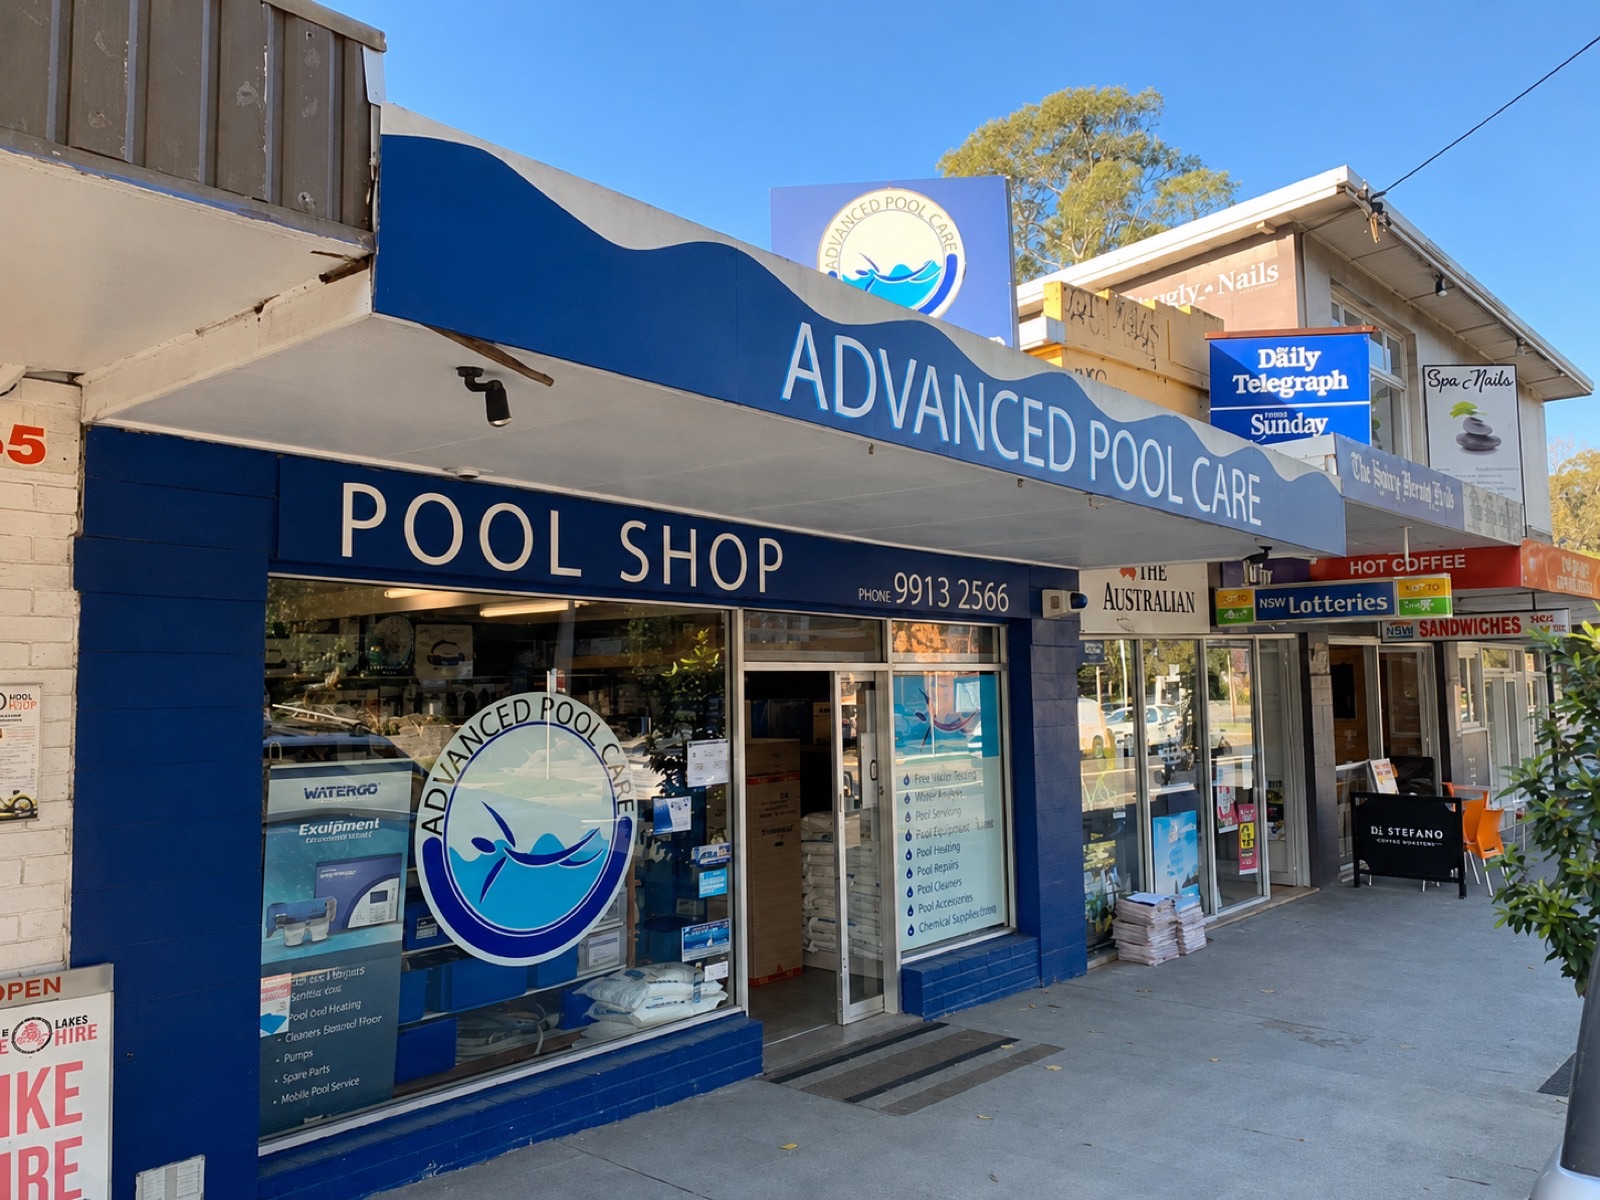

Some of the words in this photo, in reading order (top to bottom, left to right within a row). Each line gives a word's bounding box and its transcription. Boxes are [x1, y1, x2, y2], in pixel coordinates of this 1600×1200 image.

[825, 199, 881, 270] ADVANCED
[885, 196, 927, 218] POOL
[928, 212, 958, 253] CARE
[1217, 261, 1279, 295] Nails
[1232, 369, 1349, 398] Telegraph
[1427, 368, 1459, 393] Spa
[780, 321, 1076, 473] ADVANCED
[1088, 419, 1184, 505] POOL
[1190, 456, 1263, 527] CARE
[1251, 412, 1329, 437] Sunday
[0, 424, 46, 465] 5
[340, 481, 582, 578] POOL
[619, 520, 784, 593] SHOP
[1140, 565, 1168, 581] THE
[1350, 559, 1388, 575] HOT
[1392, 554, 1466, 572] COFFEE
[858, 587, 892, 603] PHONE
[894, 571, 950, 608] 9913
[957, 578, 1010, 612] 2566
[1103, 582, 1195, 613] AUSTRALIAN
[1260, 597, 1286, 608] NSW
[1288, 593, 1388, 614] Lotteries
[1387, 625, 1413, 636] NSW
[1419, 616, 1522, 638] SANDWICHES
[421, 698, 531, 836] ADVANCED
[540, 696, 601, 747] POOL
[601, 743, 635, 815] CARE
[1388, 827, 1443, 839] STEFANO
[916, 845, 932, 858] Pool
[917, 864, 933, 876] Pool
[917, 882, 933, 895] Pool
[918, 901, 934, 914] Pool
[919, 915, 951, 933] Chemical
[0, 976, 61, 1001] PEN
[55, 1015, 88, 1029] LAKES
[55, 1024, 97, 1046] HIRE
[285, 1027, 321, 1043] Cleaners
[283, 1050, 314, 1064] Pumps
[282, 1070, 307, 1085] Spare
[309, 1065, 330, 1077] Parts
[281, 1088, 310, 1104] Mobile
[311, 1083, 330, 1097] Pool
[331, 1076, 360, 1091] Service
